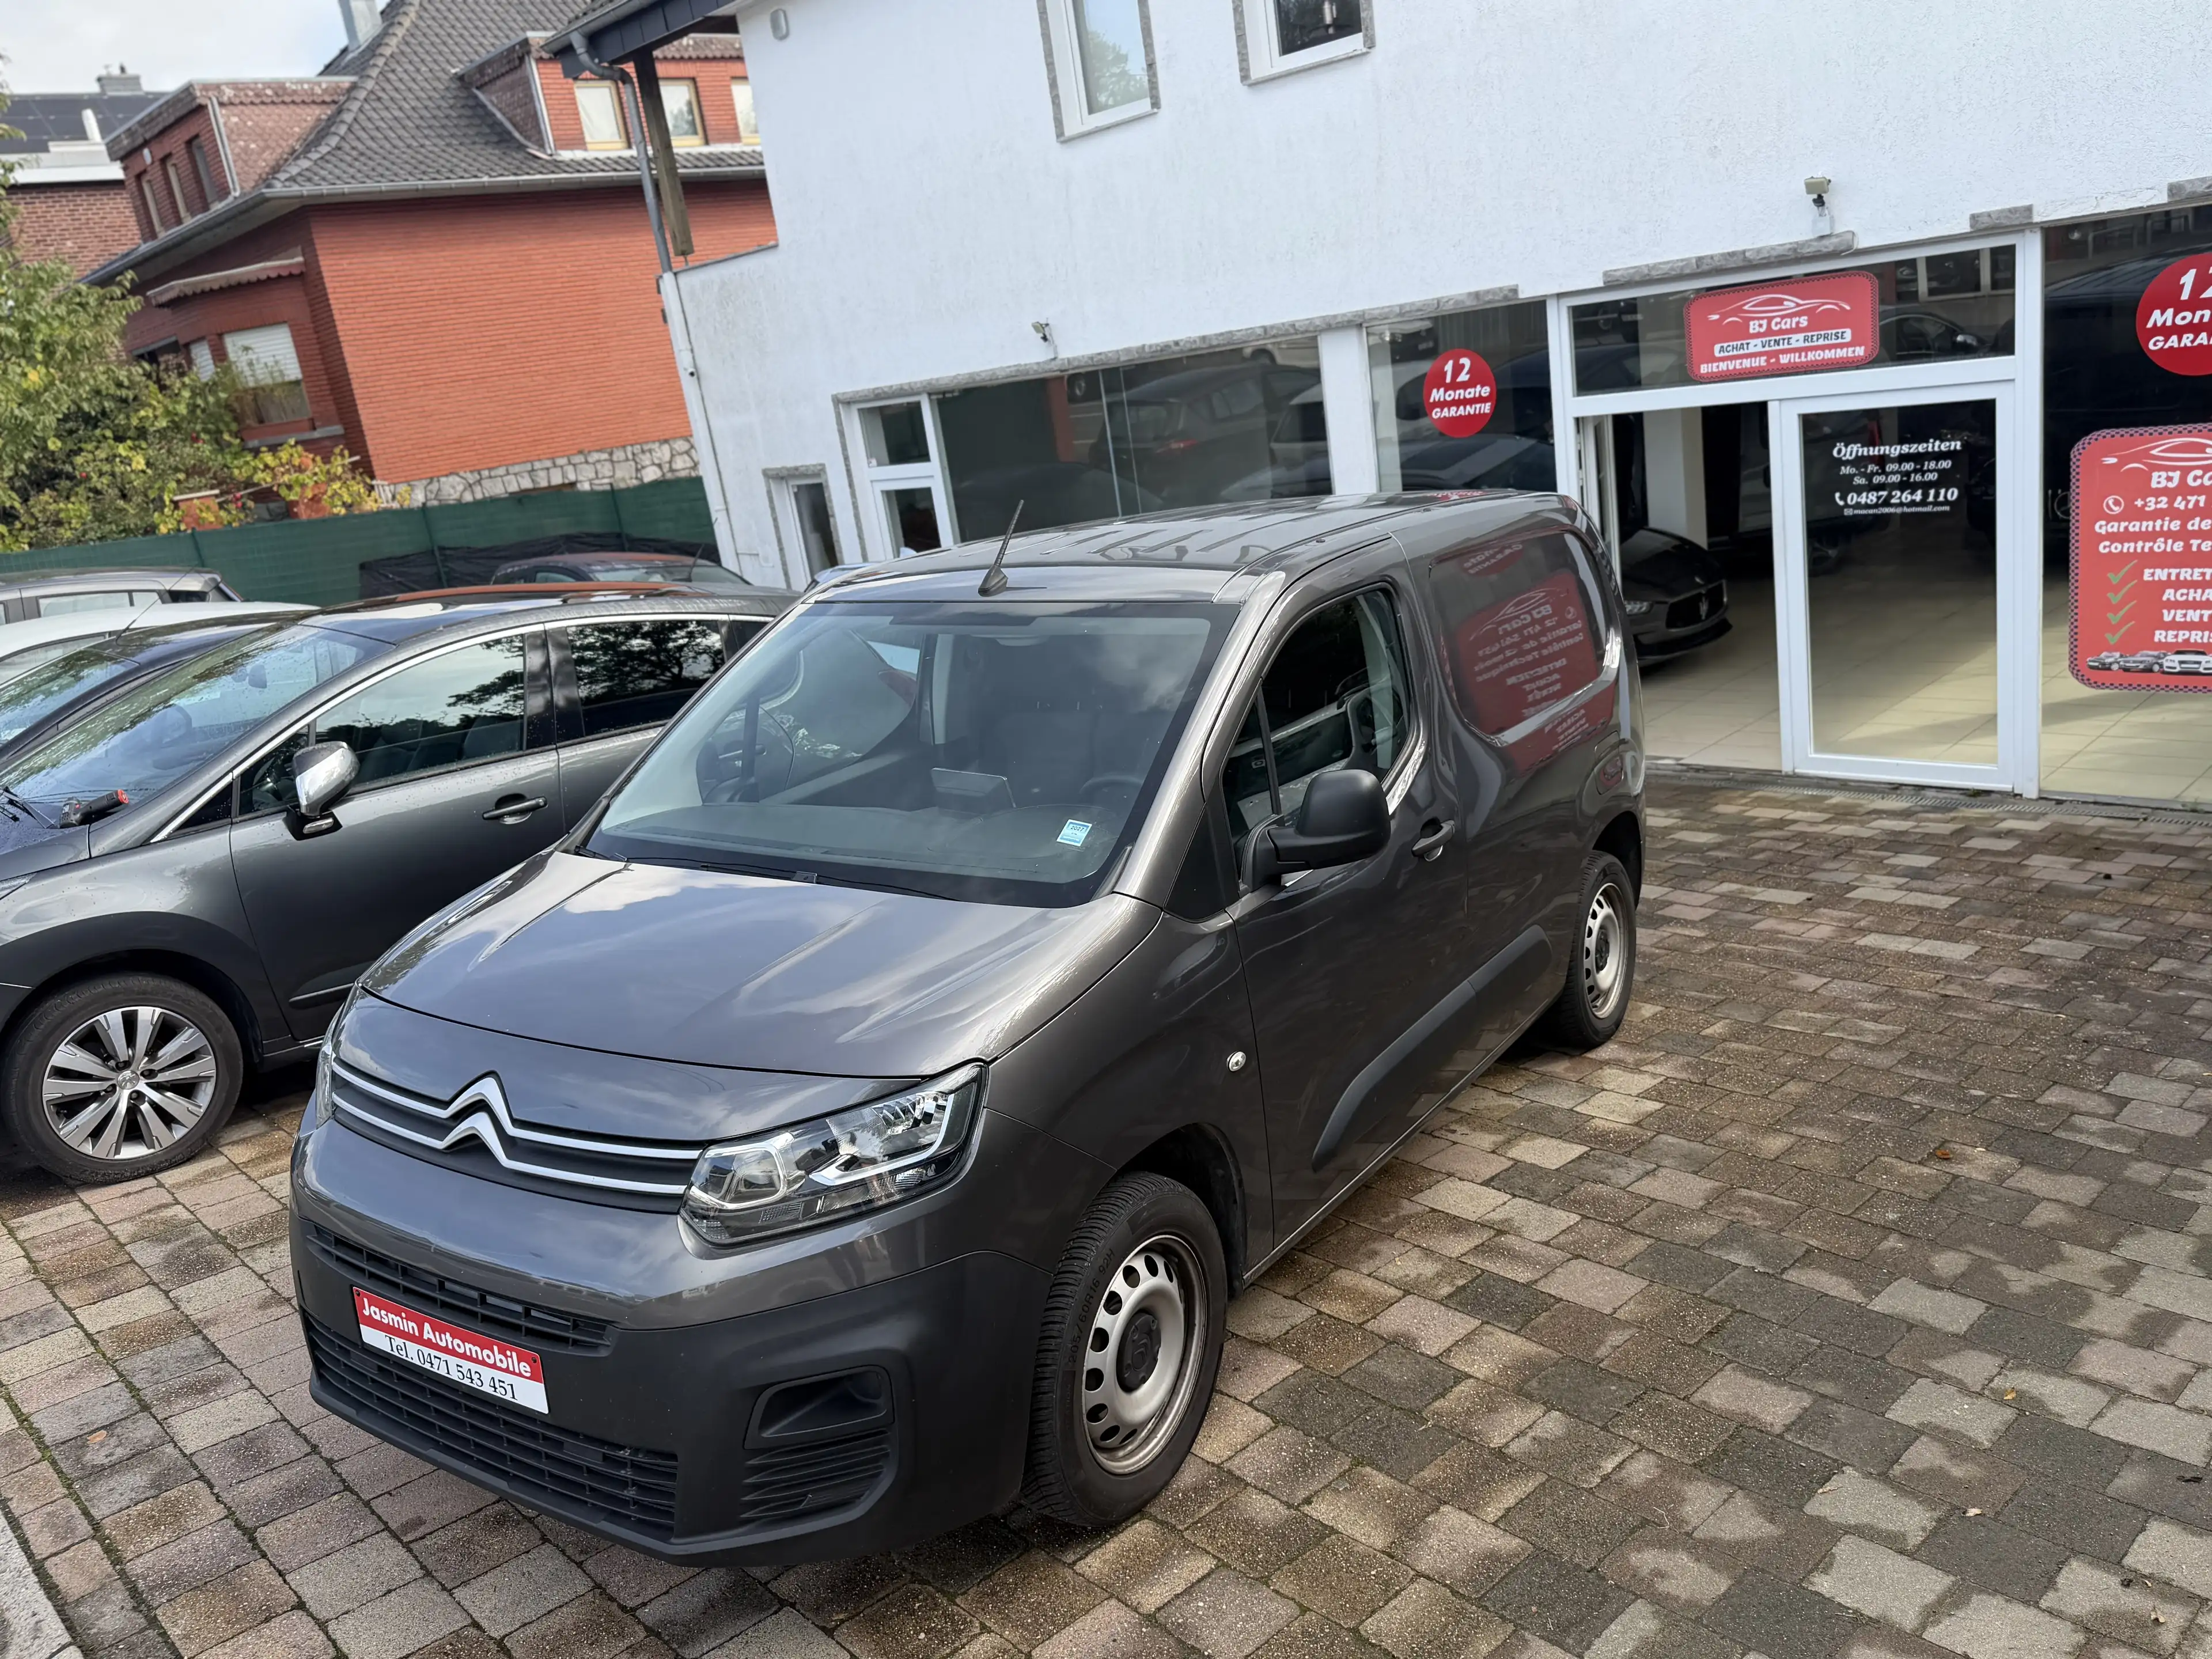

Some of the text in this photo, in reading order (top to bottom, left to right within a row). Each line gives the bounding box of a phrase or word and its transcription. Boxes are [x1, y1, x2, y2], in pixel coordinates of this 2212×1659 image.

[1749, 316, 1808, 334] BJ Cars
[1718, 342, 1751, 354] ACHAT
[1760, 336, 1793, 349] VENTE
[1803, 331, 1847, 344] REPRISE
[2148, 332, 2212, 350] GARA
[1700, 356, 1767, 373] BIENVENUE
[1779, 346, 1865, 363] WILLKOMMEN
[1444, 357, 1471, 383] 12
[1429, 384, 1491, 403] Monate
[1431, 402, 1491, 419] GARANTIE
[1832, 438, 1961, 460] Öffnungszeiten
[1840, 465, 1858, 475] Mo.
[1867, 464, 1882, 474] Fr.
[1885, 462, 1914, 472] 09.00
[1923, 460, 1952, 470] 18.00
[1853, 476, 1868, 485] Sa.
[1872, 474, 1900, 484] 09.00
[1909, 472, 1938, 482] 16.00
[2151, 471, 2180, 488] BJ
[1847, 487, 1959, 505] 0487 264 110
[2134, 495, 2206, 511] +32 471
[2094, 517, 2212, 535] Garantie de
[2099, 537, 2212, 553] Contrôle Te
[2162, 609, 2212, 622] VENT
[2154, 630, 2212, 643] REPRI
[362, 1297, 532, 1377] Jasmin Automobile
[385, 1335, 518, 1401] Tel. 0471 543 451
